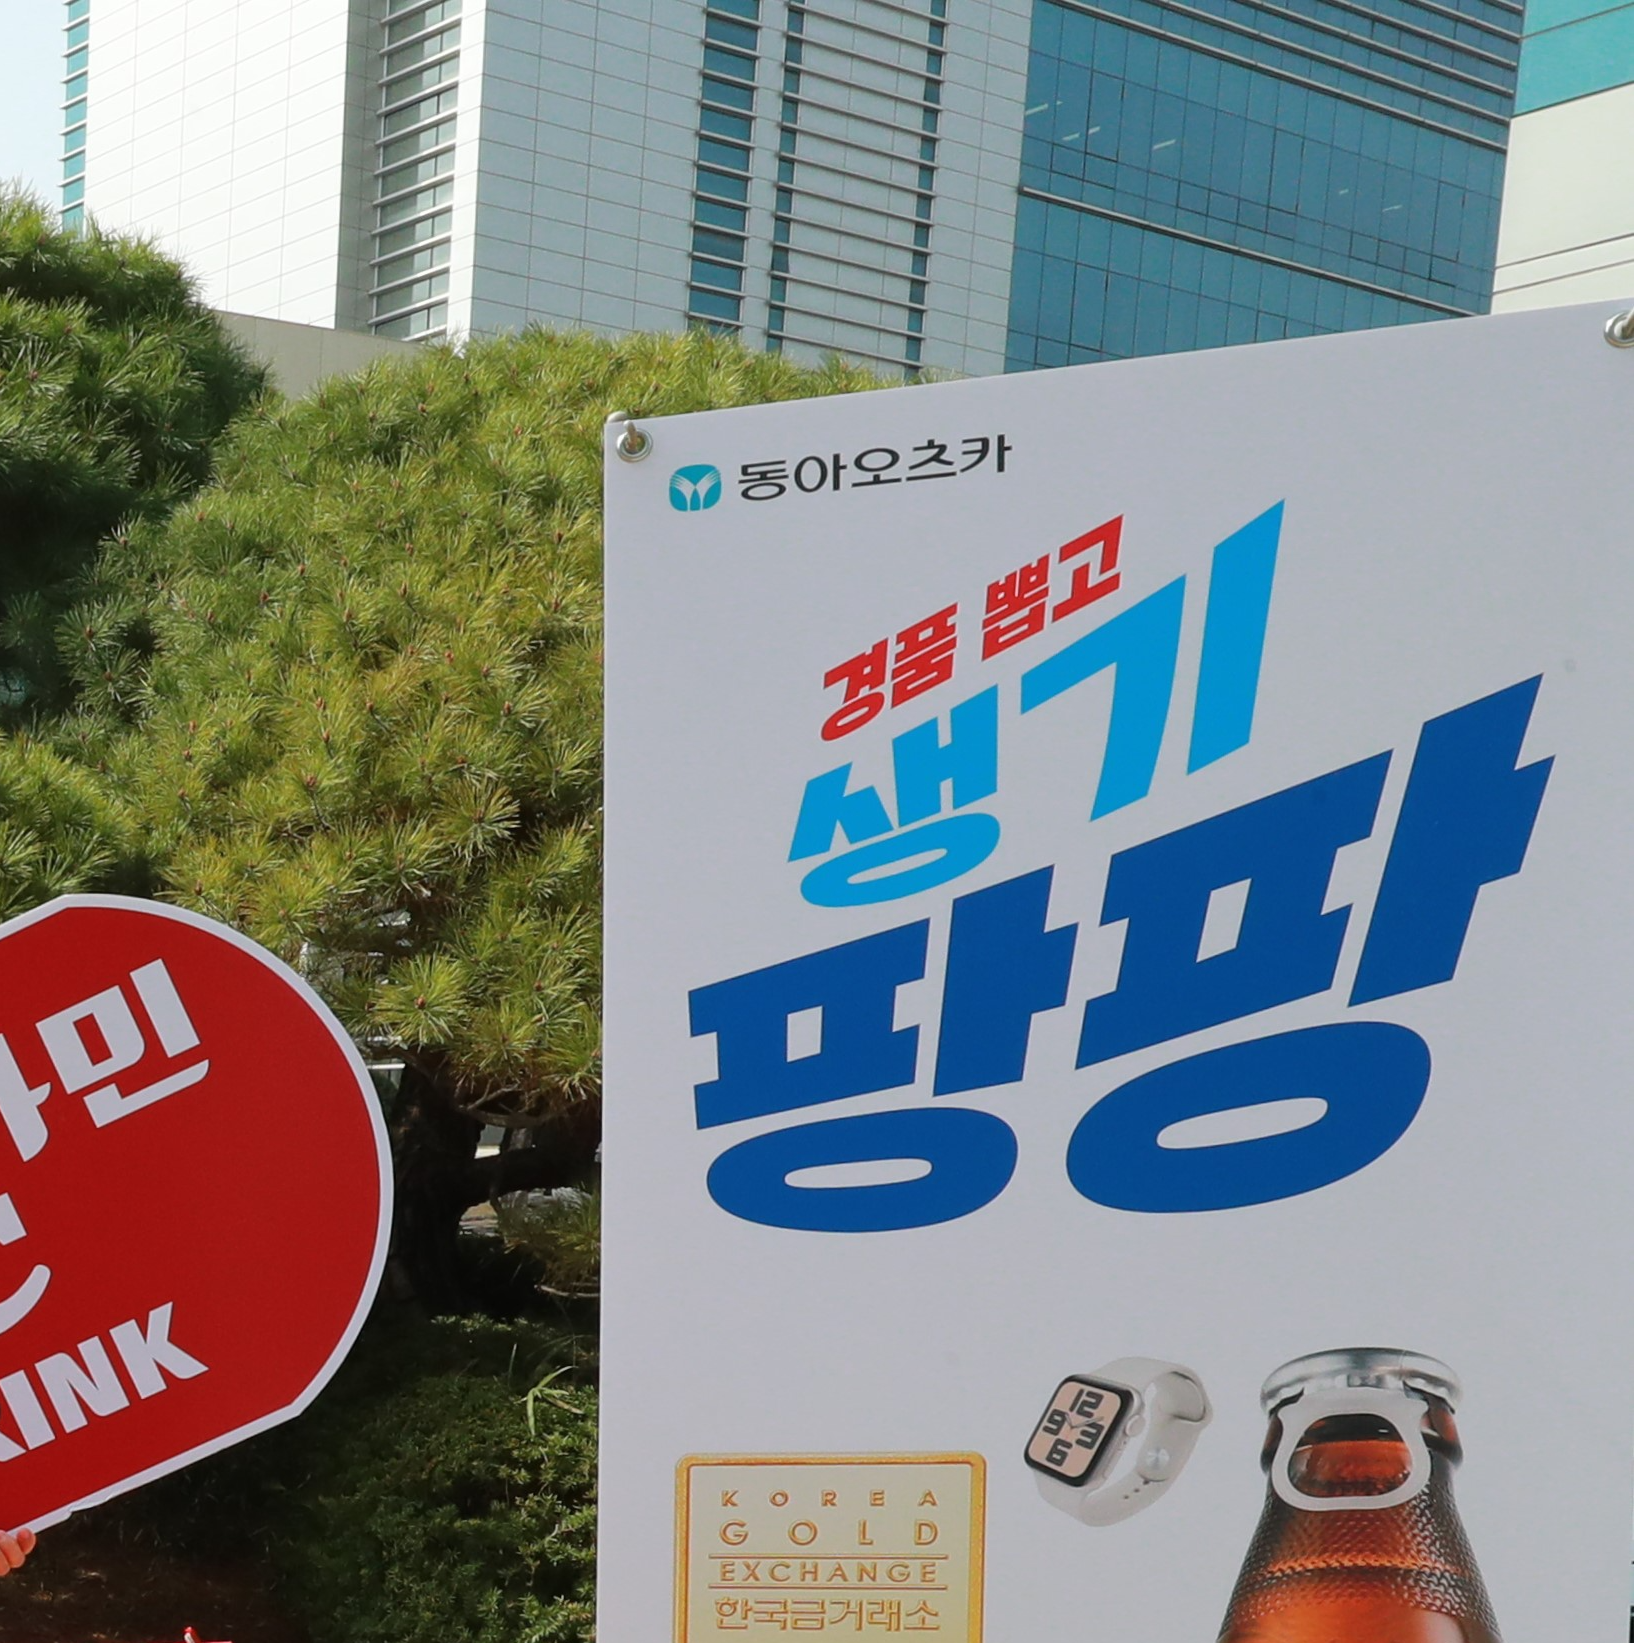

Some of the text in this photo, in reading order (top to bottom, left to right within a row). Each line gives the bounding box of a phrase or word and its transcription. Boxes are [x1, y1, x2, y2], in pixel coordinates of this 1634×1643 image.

[736, 433, 1013, 504] 동아오츠카
[819, 513, 1125, 743] 경품 뽑고
[787, 498, 1286, 909] 생기
[687, 672, 1556, 1233] 팡팡
[1069, 1389, 1104, 1418] 12
[1042, 1409, 1105, 1450] 9 3
[1045, 1438, 1073, 1467] 6
[719, 1487, 938, 1509] KOREA
[719, 1518, 939, 1548] GOLD
[719, 1560, 937, 1585] EXCHANGE
[712, 1595, 941, 1634] 한국금거래소
